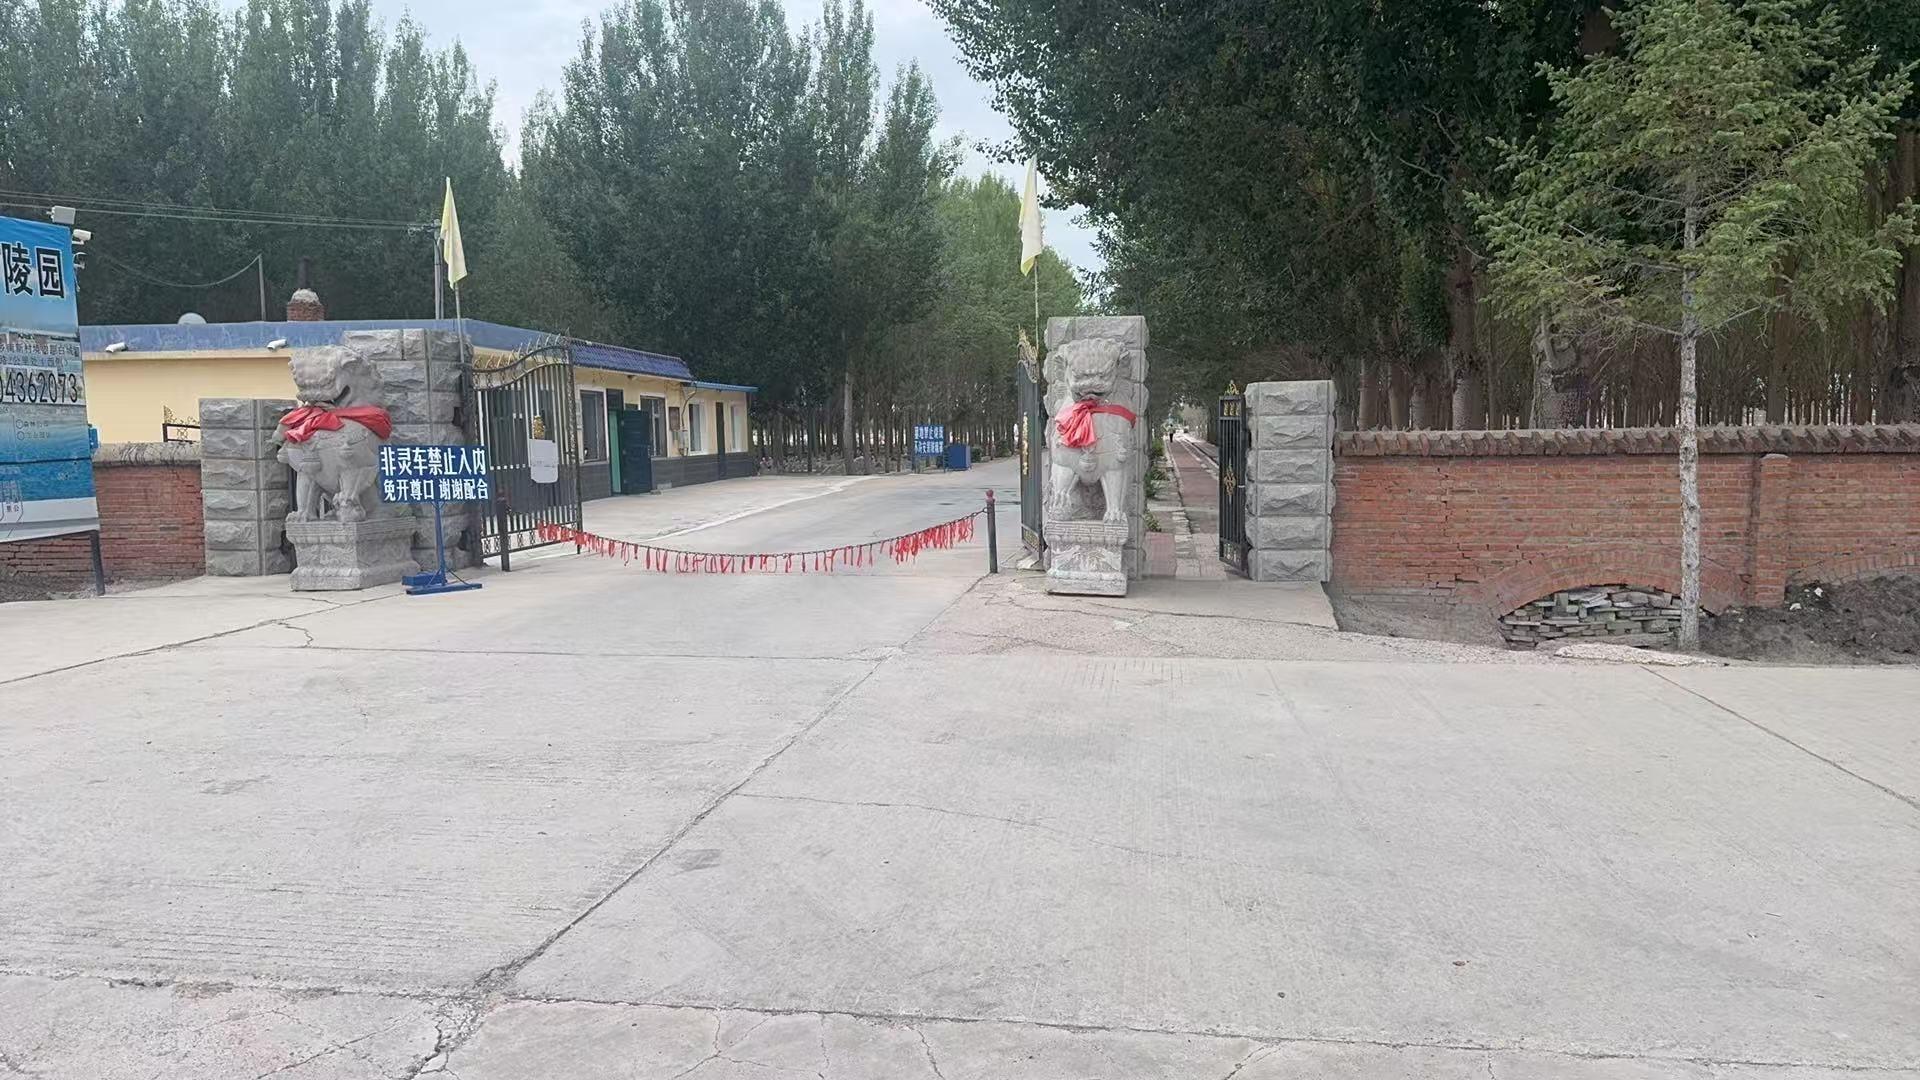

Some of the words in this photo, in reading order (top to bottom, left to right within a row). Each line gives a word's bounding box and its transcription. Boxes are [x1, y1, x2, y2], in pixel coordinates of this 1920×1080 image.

[1, 242, 64, 298] 陵园
[380, 446, 487, 476] 非灵车禁止入内
[383, 479, 435, 501] 免开尊口
[439, 479, 489, 501] 谢谢配合
